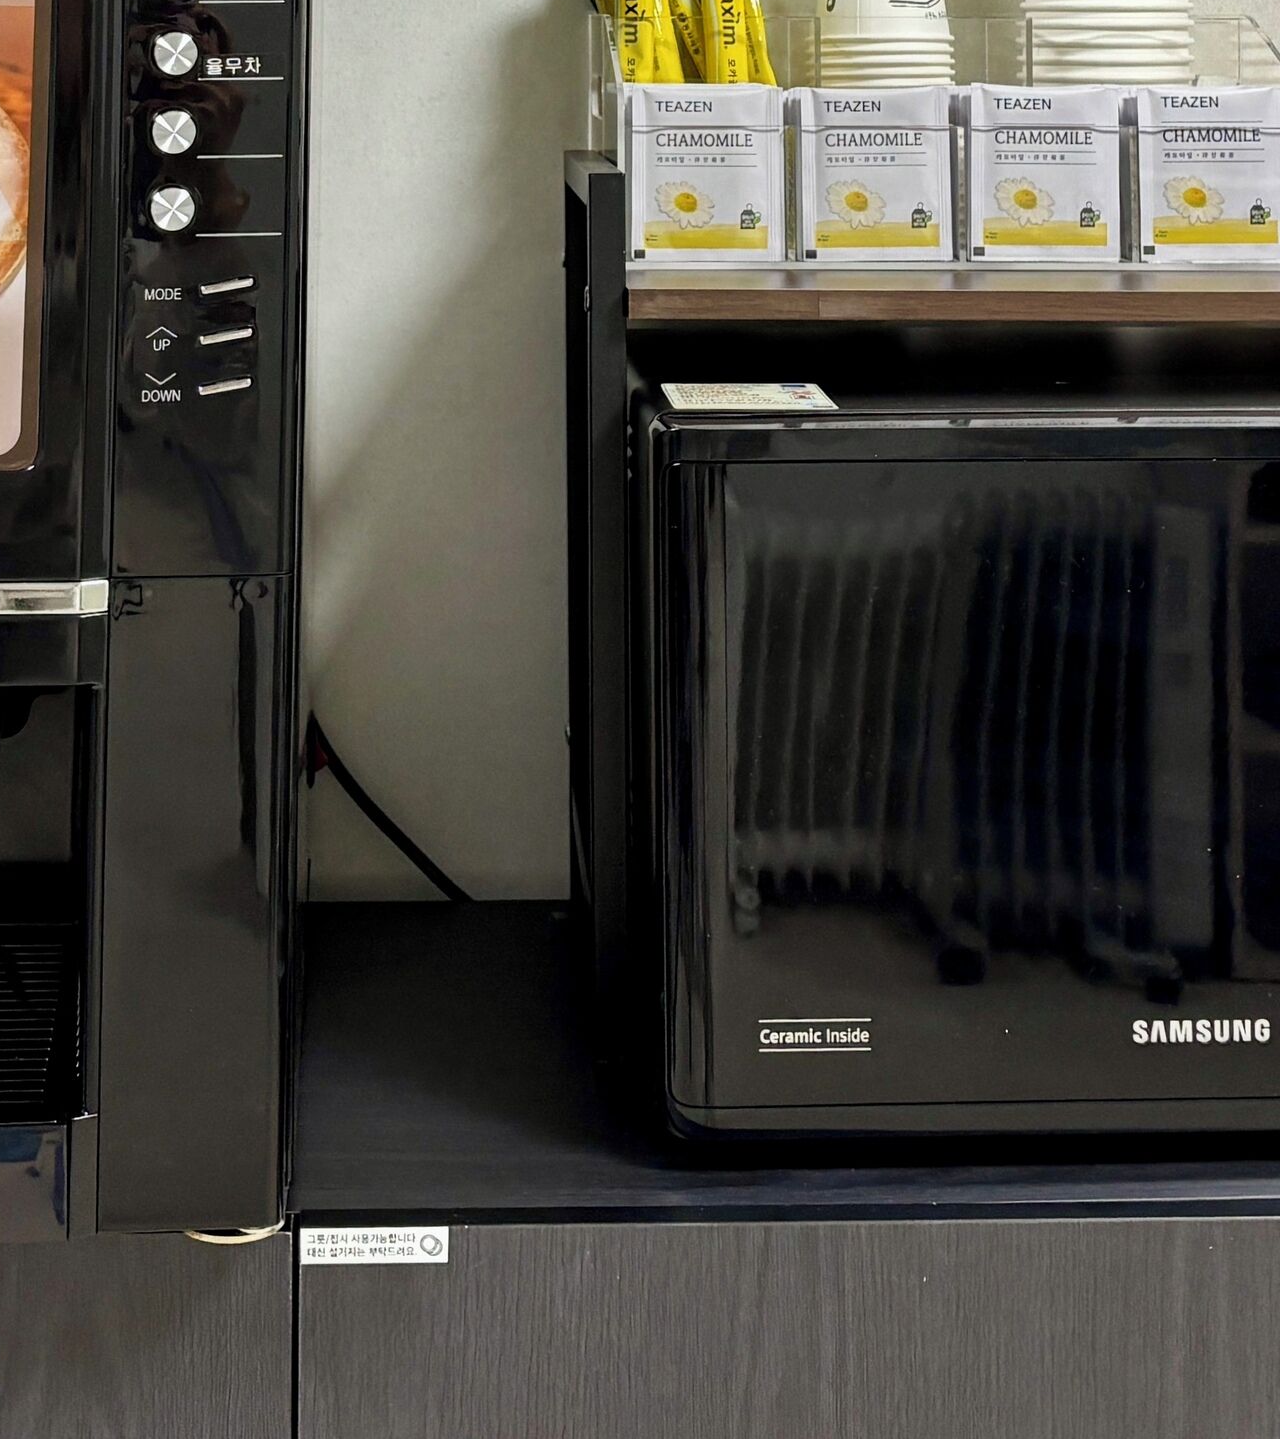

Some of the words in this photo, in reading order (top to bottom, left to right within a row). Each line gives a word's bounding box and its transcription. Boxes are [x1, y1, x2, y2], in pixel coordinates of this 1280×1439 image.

[205, 57, 261, 75] 율무차
[655, 101, 713, 113] TEAZEN
[824, 100, 882, 112] TEAZEN
[993, 98, 1052, 110] TEAZEN
[1160, 96, 1220, 108] TEAZEN
[656, 133, 754, 148] CHAMOMILE
[825, 132, 923, 147] CHAMOMILE
[994, 131, 1093, 145] CHAMOMILE
[1162, 128, 1261, 143] CHAMOMILE
[144, 287, 182, 301] MODE
[153, 338, 171, 353] UP
[141, 390, 181, 404] DOWN
[760, 1028, 822, 1044] Ceramic
[826, 1027, 870, 1043] Inside
[1132, 1019, 1271, 1044] SAMSUNG
